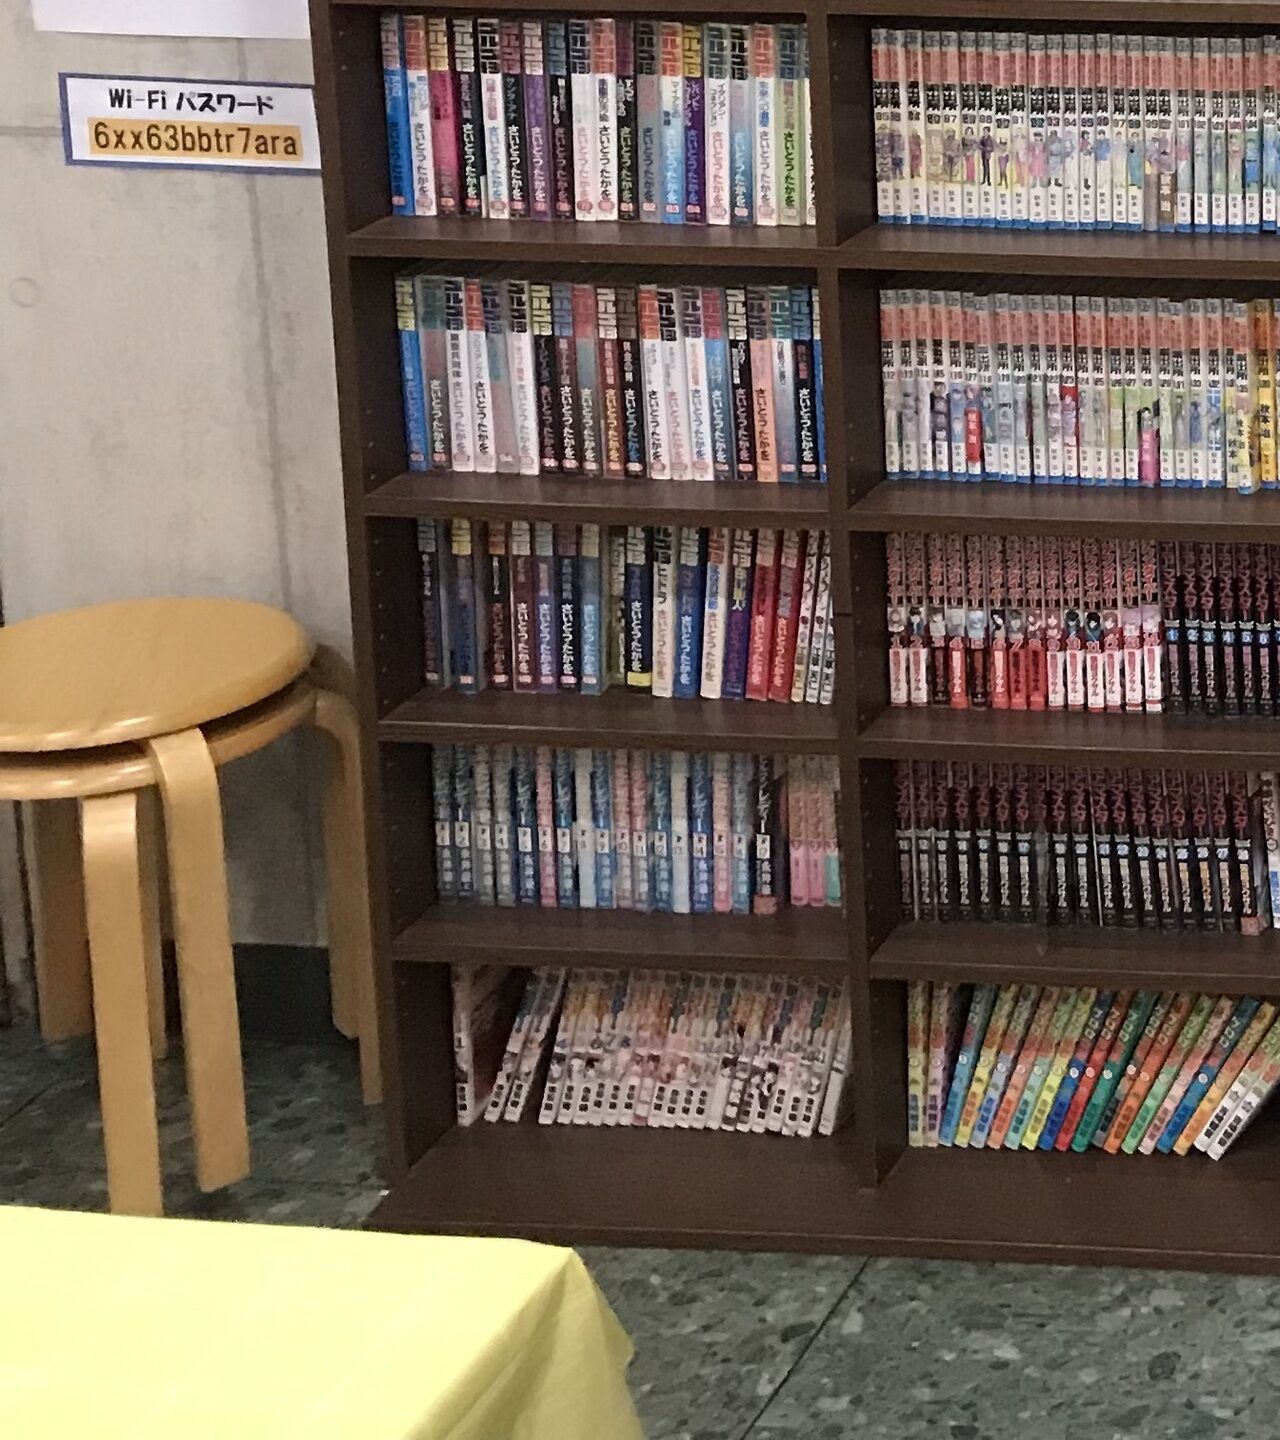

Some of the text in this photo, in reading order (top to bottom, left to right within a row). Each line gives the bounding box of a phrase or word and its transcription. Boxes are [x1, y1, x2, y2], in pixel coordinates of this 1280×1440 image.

[108, 88, 274, 115] Wi-Fi パスワード
[94, 121, 298, 156] 6xx63bbtr7ara
